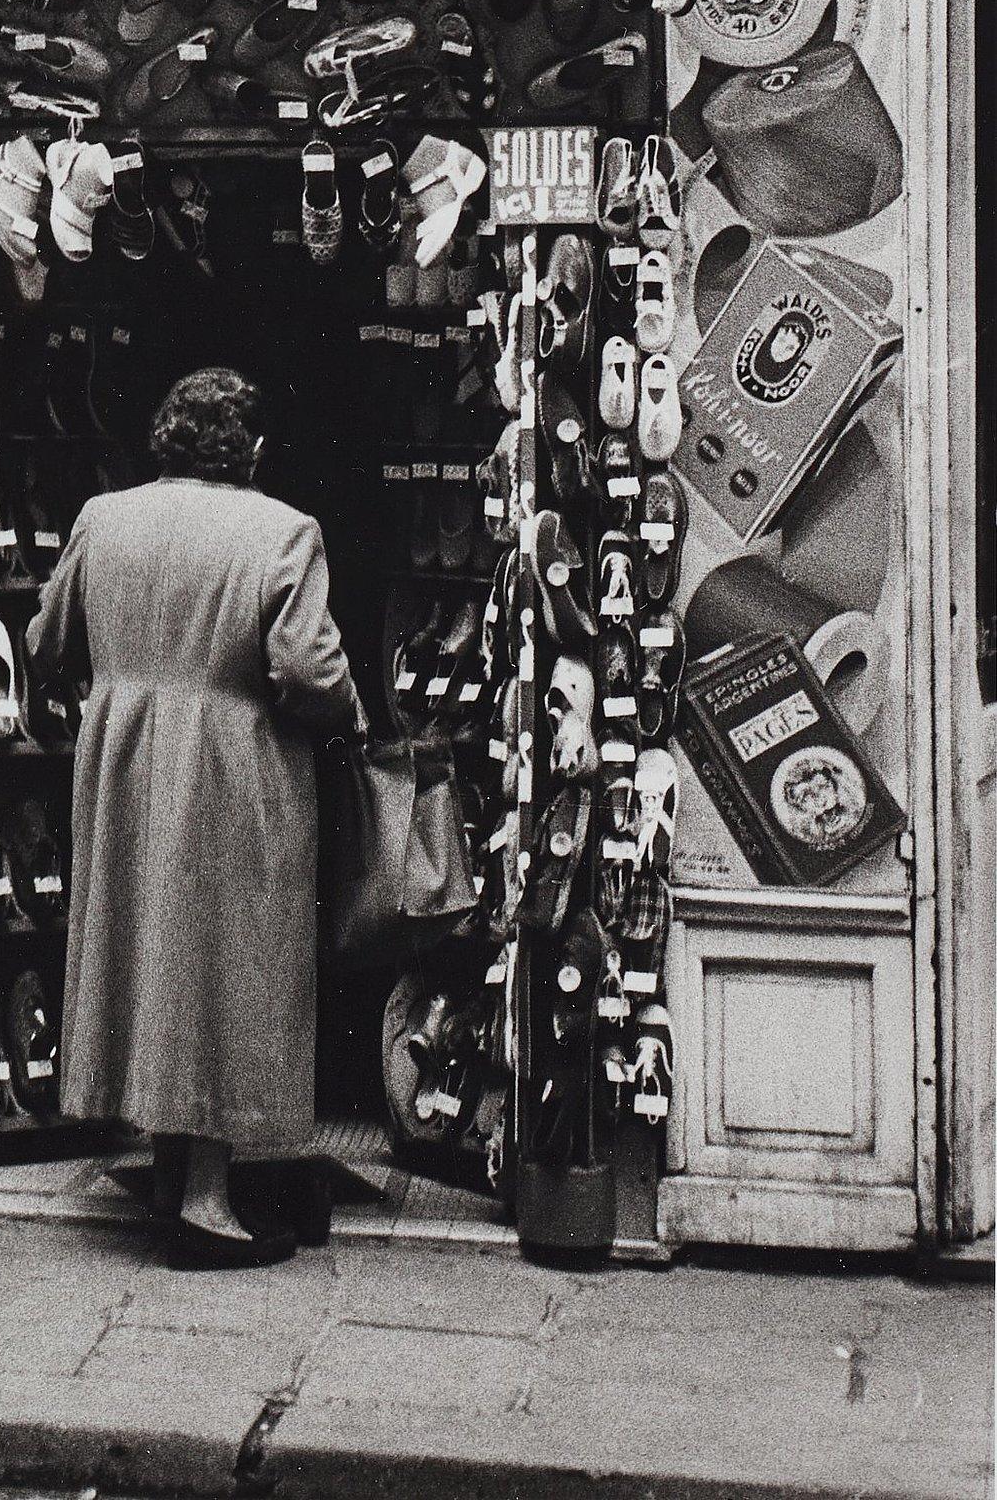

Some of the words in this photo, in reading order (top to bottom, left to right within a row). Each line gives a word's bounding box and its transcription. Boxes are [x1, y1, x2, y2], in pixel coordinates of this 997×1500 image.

[731, 17, 757, 33] 40
[493, 128, 590, 188] SOLDES
[496, 189, 533, 220] ICI
[771, 293, 832, 341] WALDES
